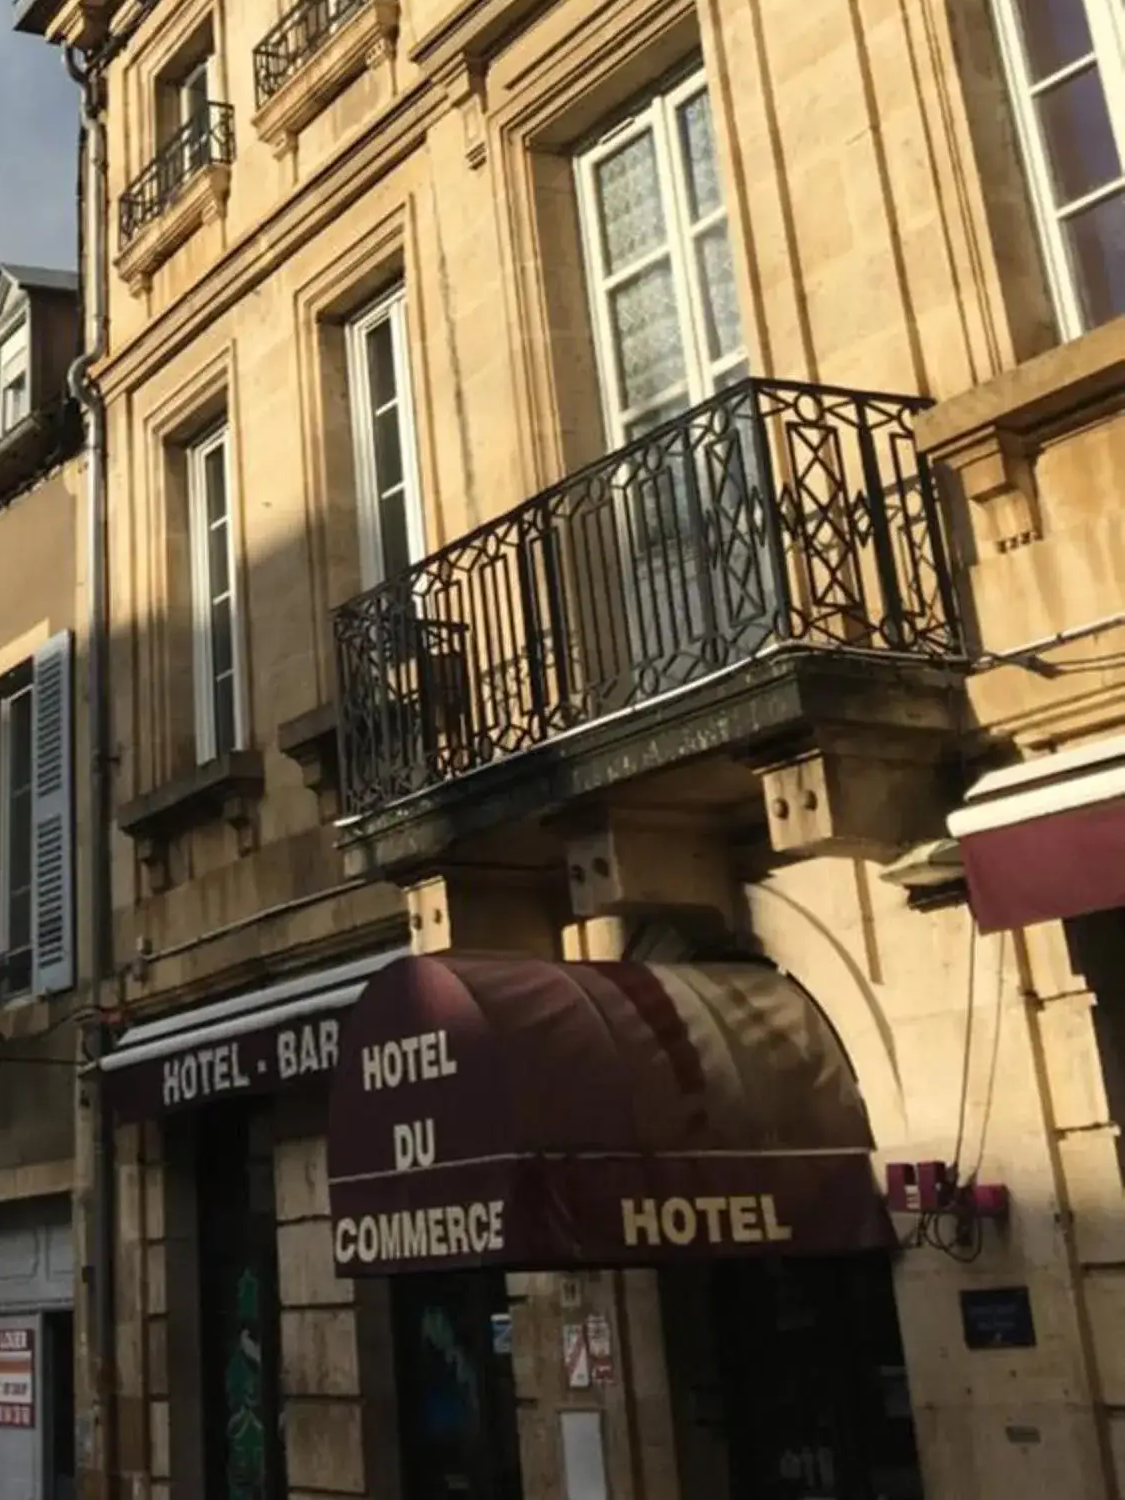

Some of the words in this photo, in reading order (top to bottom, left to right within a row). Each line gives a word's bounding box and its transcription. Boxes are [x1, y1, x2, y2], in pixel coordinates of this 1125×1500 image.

[163, 1042, 250, 1106] HOTEL
[277, 1019, 339, 1080] BAR
[361, 1029, 457, 1091] HOTEL
[393, 1118, 435, 1171] DU
[335, 1200, 504, 1264] COMMERCE
[620, 1194, 793, 1245] HOTEL
